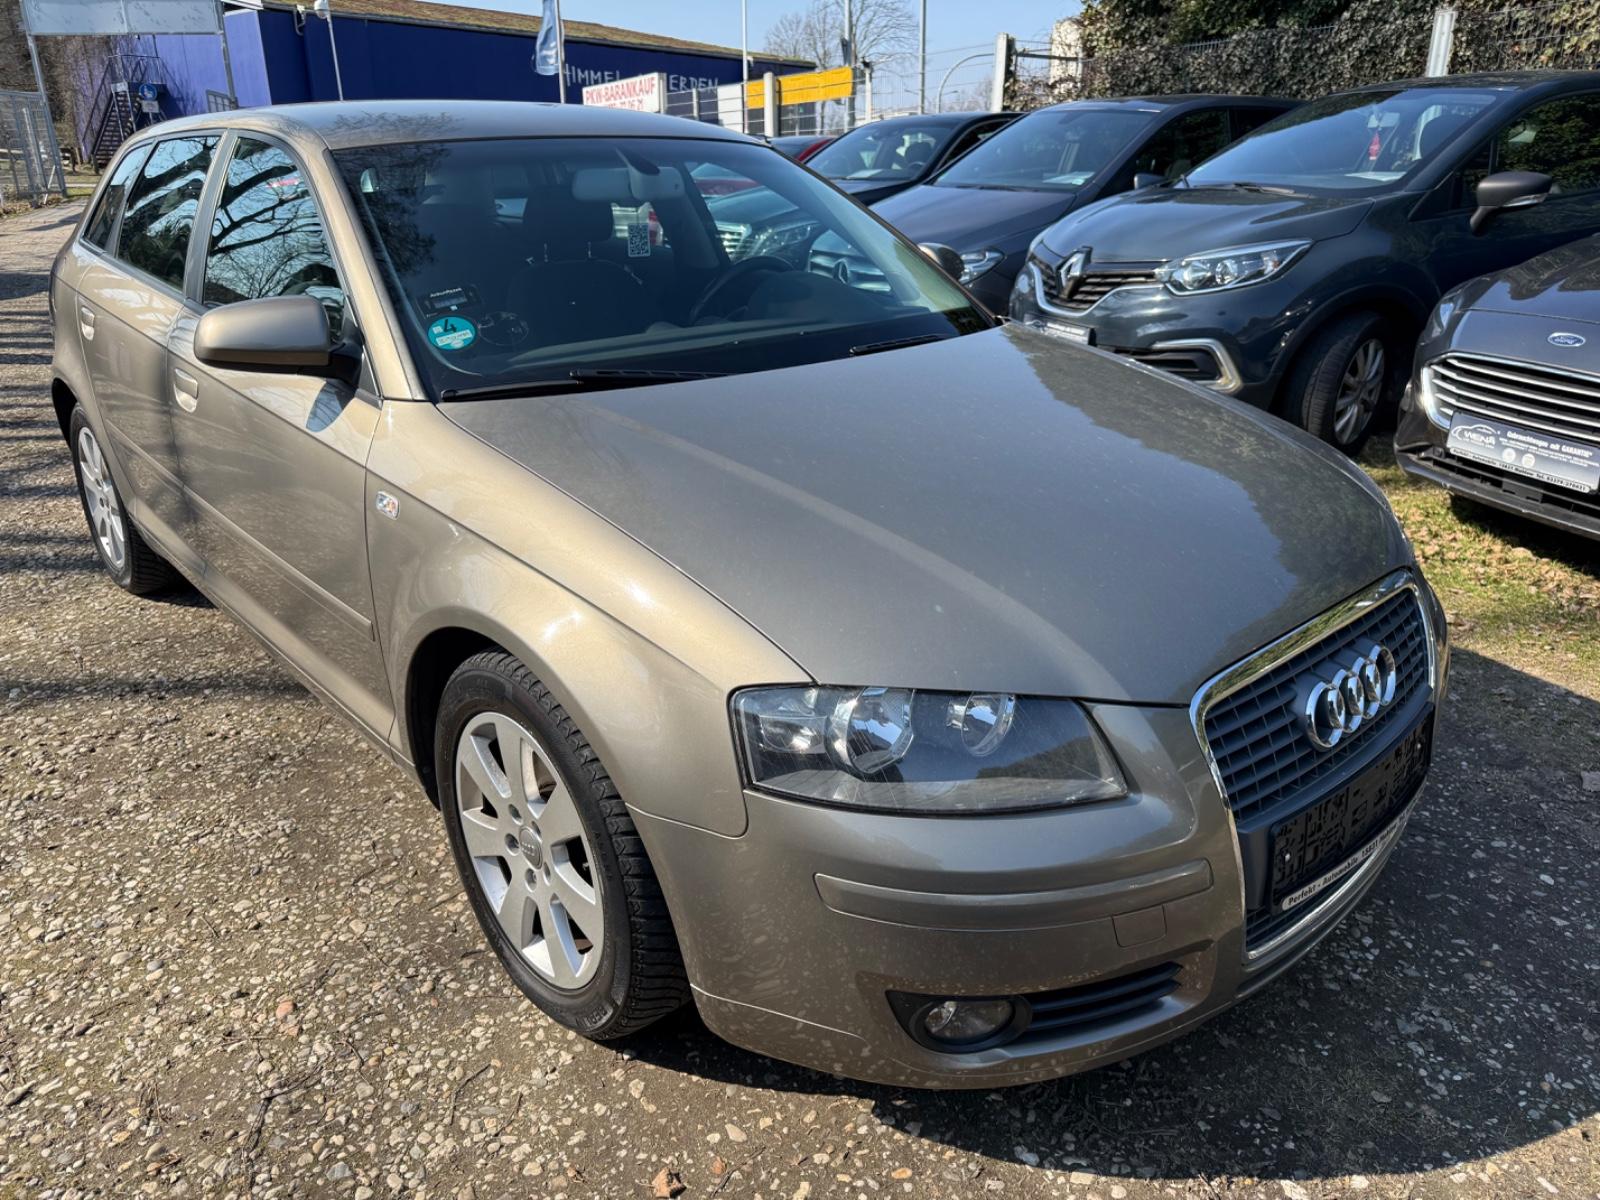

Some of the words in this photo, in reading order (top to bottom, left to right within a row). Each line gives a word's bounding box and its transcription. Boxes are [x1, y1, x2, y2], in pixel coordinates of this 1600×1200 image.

[586, 77, 656, 105] PKW-BARANKAUF
[443, 319, 457, 333] 4
[1288, 884, 1316, 906] Perfekt
[1322, 857, 1358, 886] Automobile
